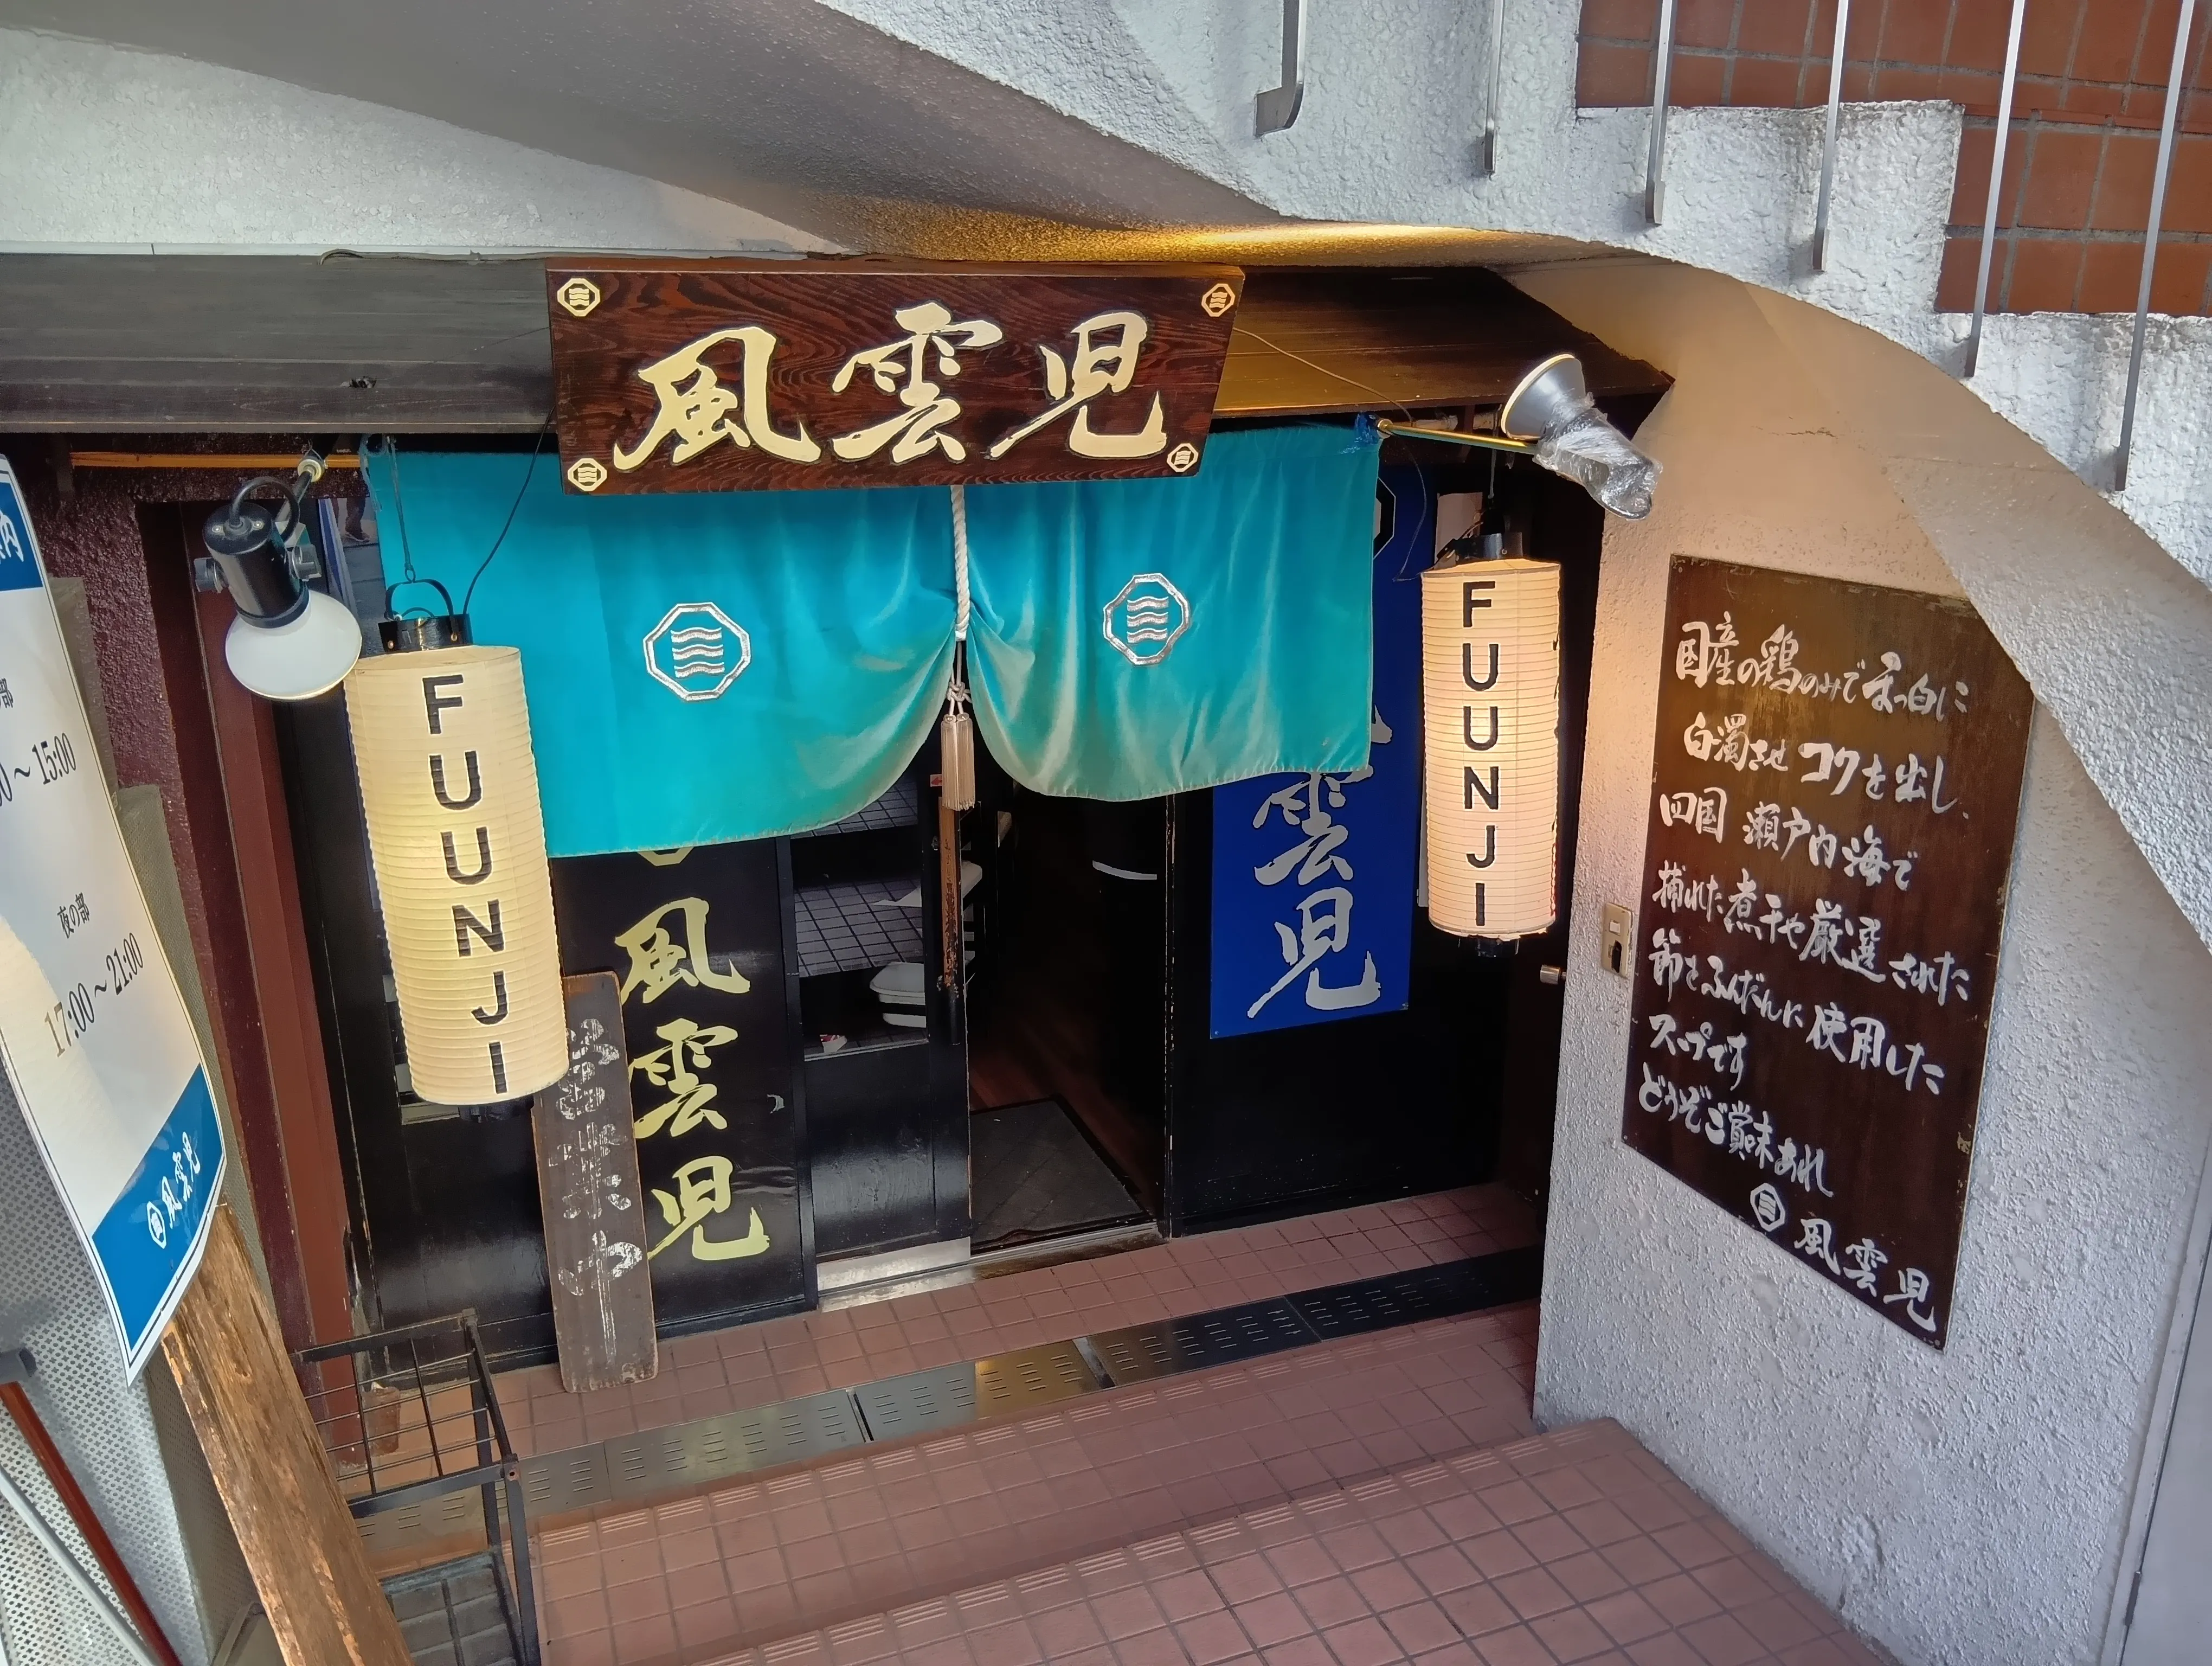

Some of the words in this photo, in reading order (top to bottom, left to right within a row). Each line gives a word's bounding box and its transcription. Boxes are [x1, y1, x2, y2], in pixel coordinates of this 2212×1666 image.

[614, 302, 1166, 471] 風雲児
[1249, 704, 1392, 1018] 雲児
[1463, 581, 1500, 926] FUUNJI
[57, 892, 89, 939] 夜の部
[422, 674, 508, 1094] FUUNJI
[162, 1131, 201, 1229] 風雲児
[615, 896, 770, 1260] 風雲児
[1794, 1219, 1936, 1331] 風雲児
